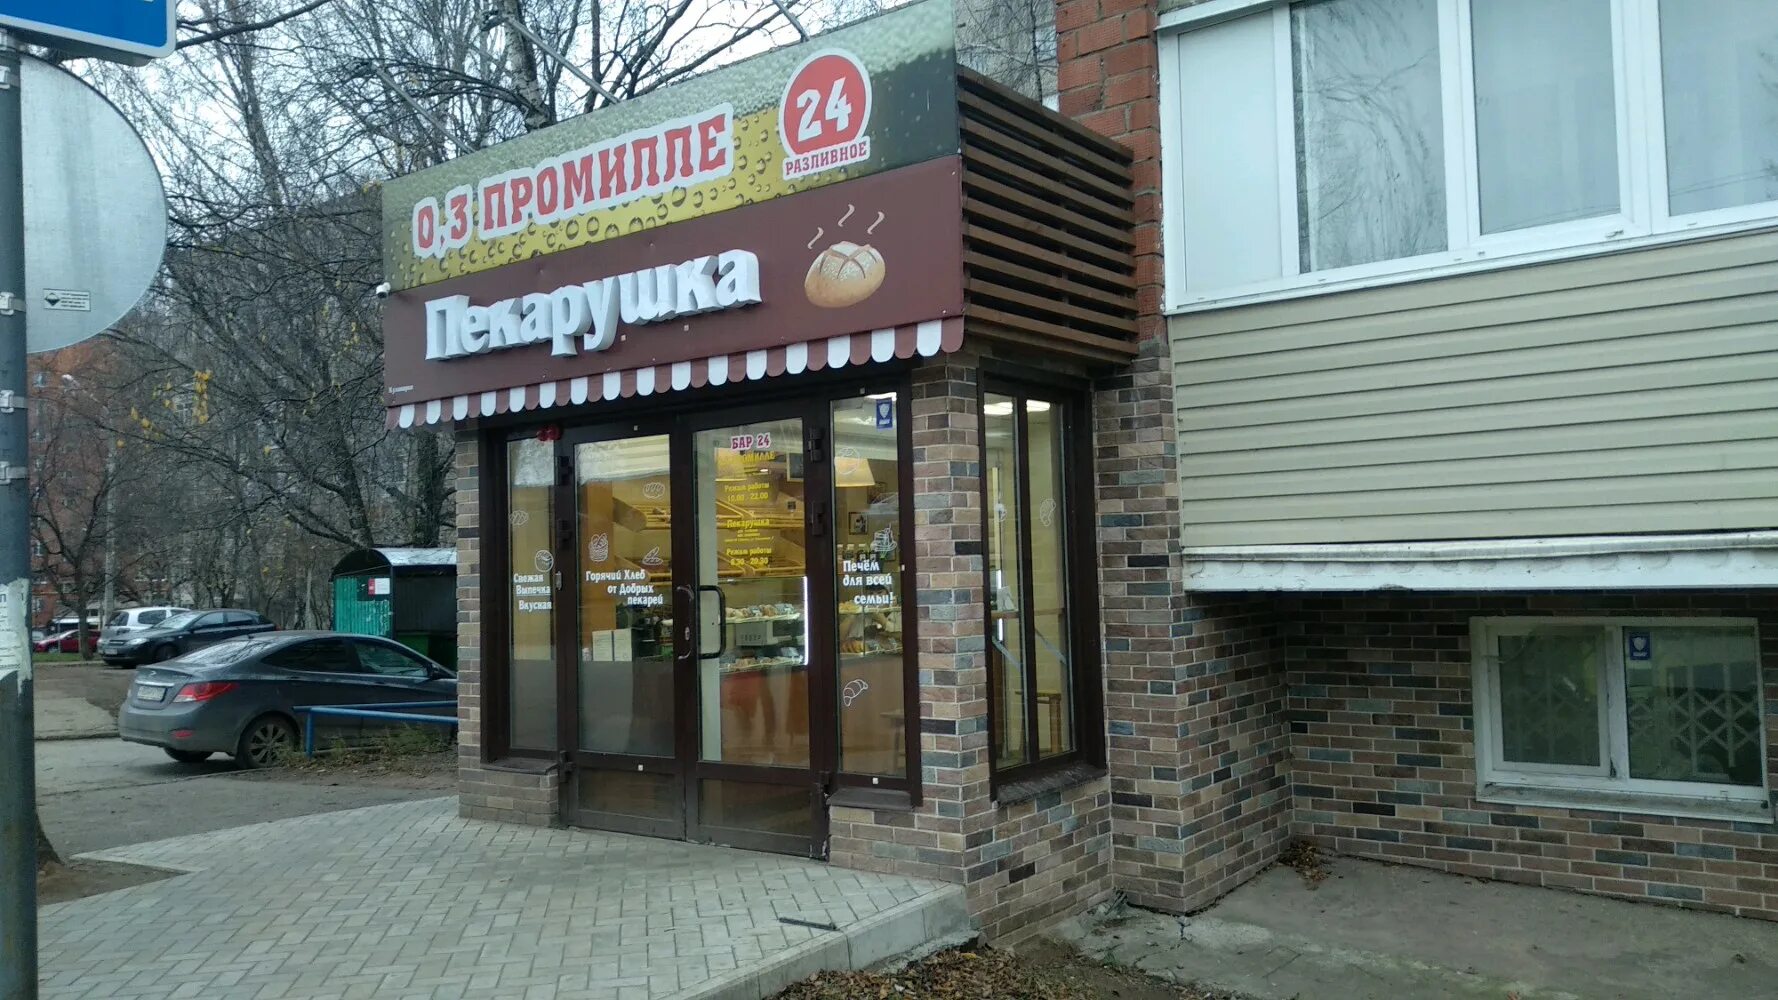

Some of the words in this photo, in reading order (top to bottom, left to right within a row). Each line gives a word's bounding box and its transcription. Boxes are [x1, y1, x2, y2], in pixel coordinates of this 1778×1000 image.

[796, 76, 852, 142] 24
[785, 141, 867, 176] РАЗЛИВНОЕ
[417, 193, 468, 249] 0,3
[482, 112, 727, 231] ПРОМИЛЛЕ
[424, 249, 762, 361] Пекарушка
[732, 436, 753, 449] БАР
[757, 434, 770, 446] 24
[843, 559, 880, 572] Печём
[513, 573, 544, 583] Свежая
[585, 571, 622, 583] Горячий
[624, 569, 646, 580] Хлеб
[843, 574, 863, 587] для
[866, 573, 893, 586] всей
[516, 585, 551, 596] Выпечка
[607, 586, 617, 594] от
[619, 583, 654, 595] Добрых
[627, 593, 664, 607] пекарей
[854, 591, 894, 605] семьи!
[518, 600, 552, 612] Вкусная
